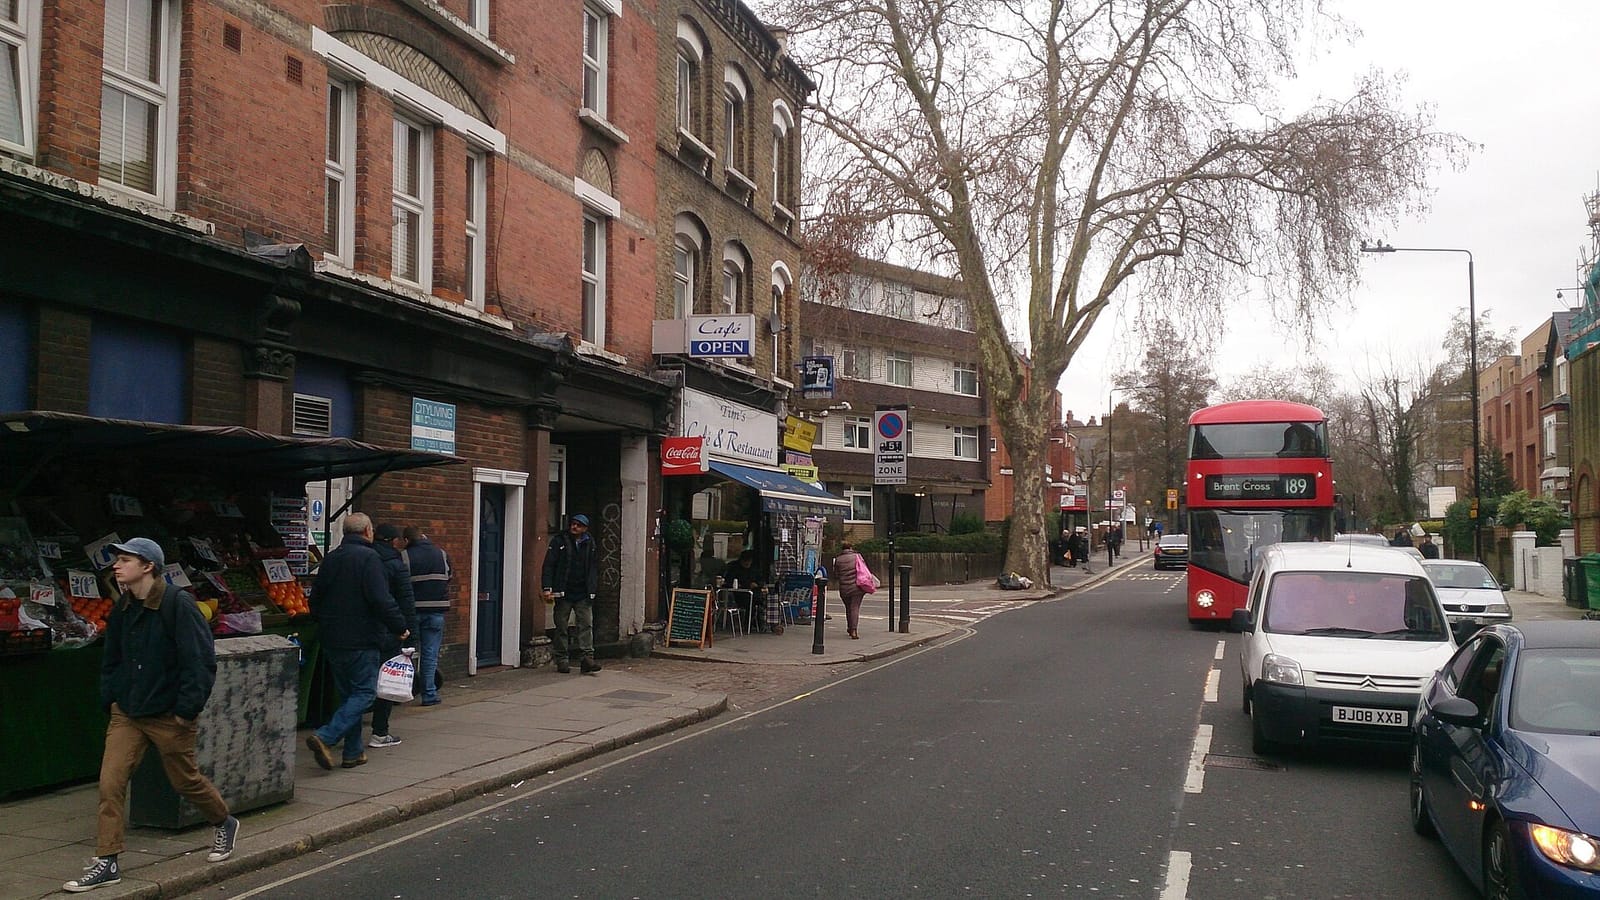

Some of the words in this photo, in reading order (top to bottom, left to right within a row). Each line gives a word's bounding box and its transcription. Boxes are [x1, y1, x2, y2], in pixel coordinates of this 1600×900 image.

[698, 319, 741, 338] Café
[698, 341, 744, 353] OPEN
[721, 404, 746, 422] Tim's
[713, 428, 724, 448] &
[727, 430, 774, 460] Restaurant
[878, 466, 903, 474] ZONE
[1213, 481, 1241, 491] Brent
[1242, 481, 1271, 491] Cross
[1284, 478, 1307, 494] 189
[1338, 708, 1373, 722] BJ08
[1376, 711, 1403, 724] XXB
